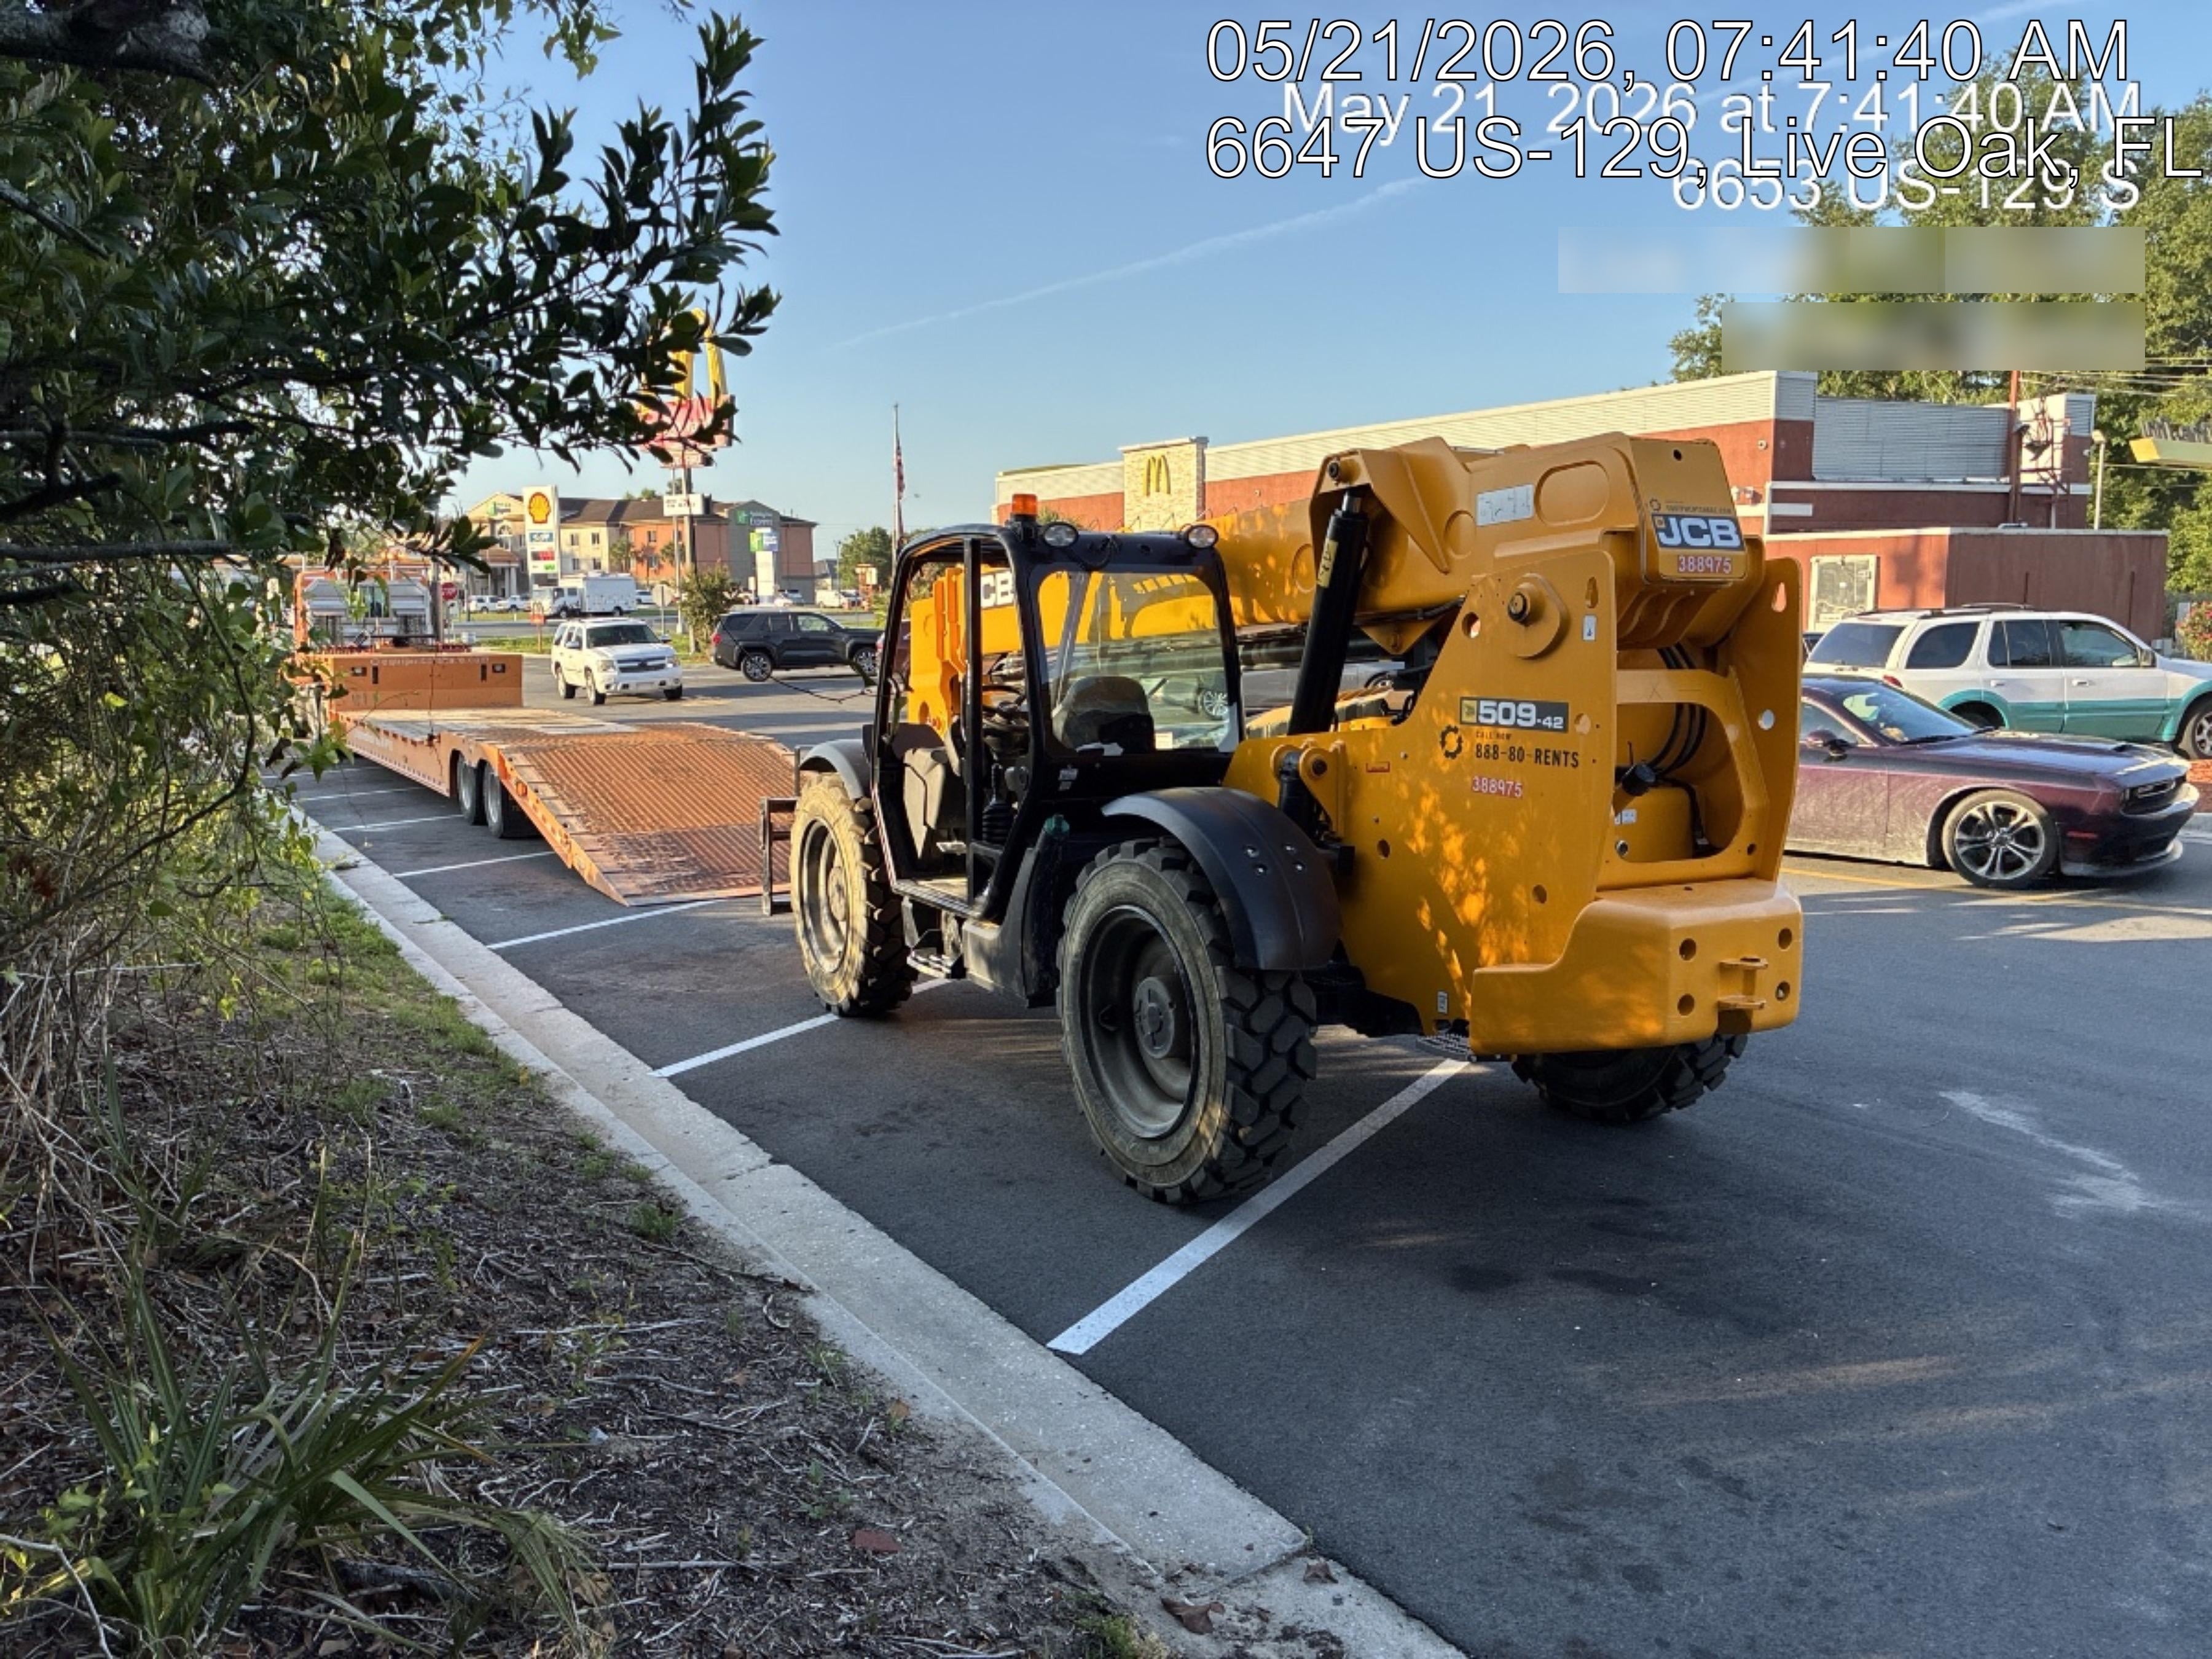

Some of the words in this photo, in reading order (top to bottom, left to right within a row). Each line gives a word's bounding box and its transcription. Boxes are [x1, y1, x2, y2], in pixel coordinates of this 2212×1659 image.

[1659, 517, 1741, 547] JCB
[1678, 554, 1732, 573] 388975
[981, 571, 1014, 608] CB
[1472, 775, 1523, 798] 388975
